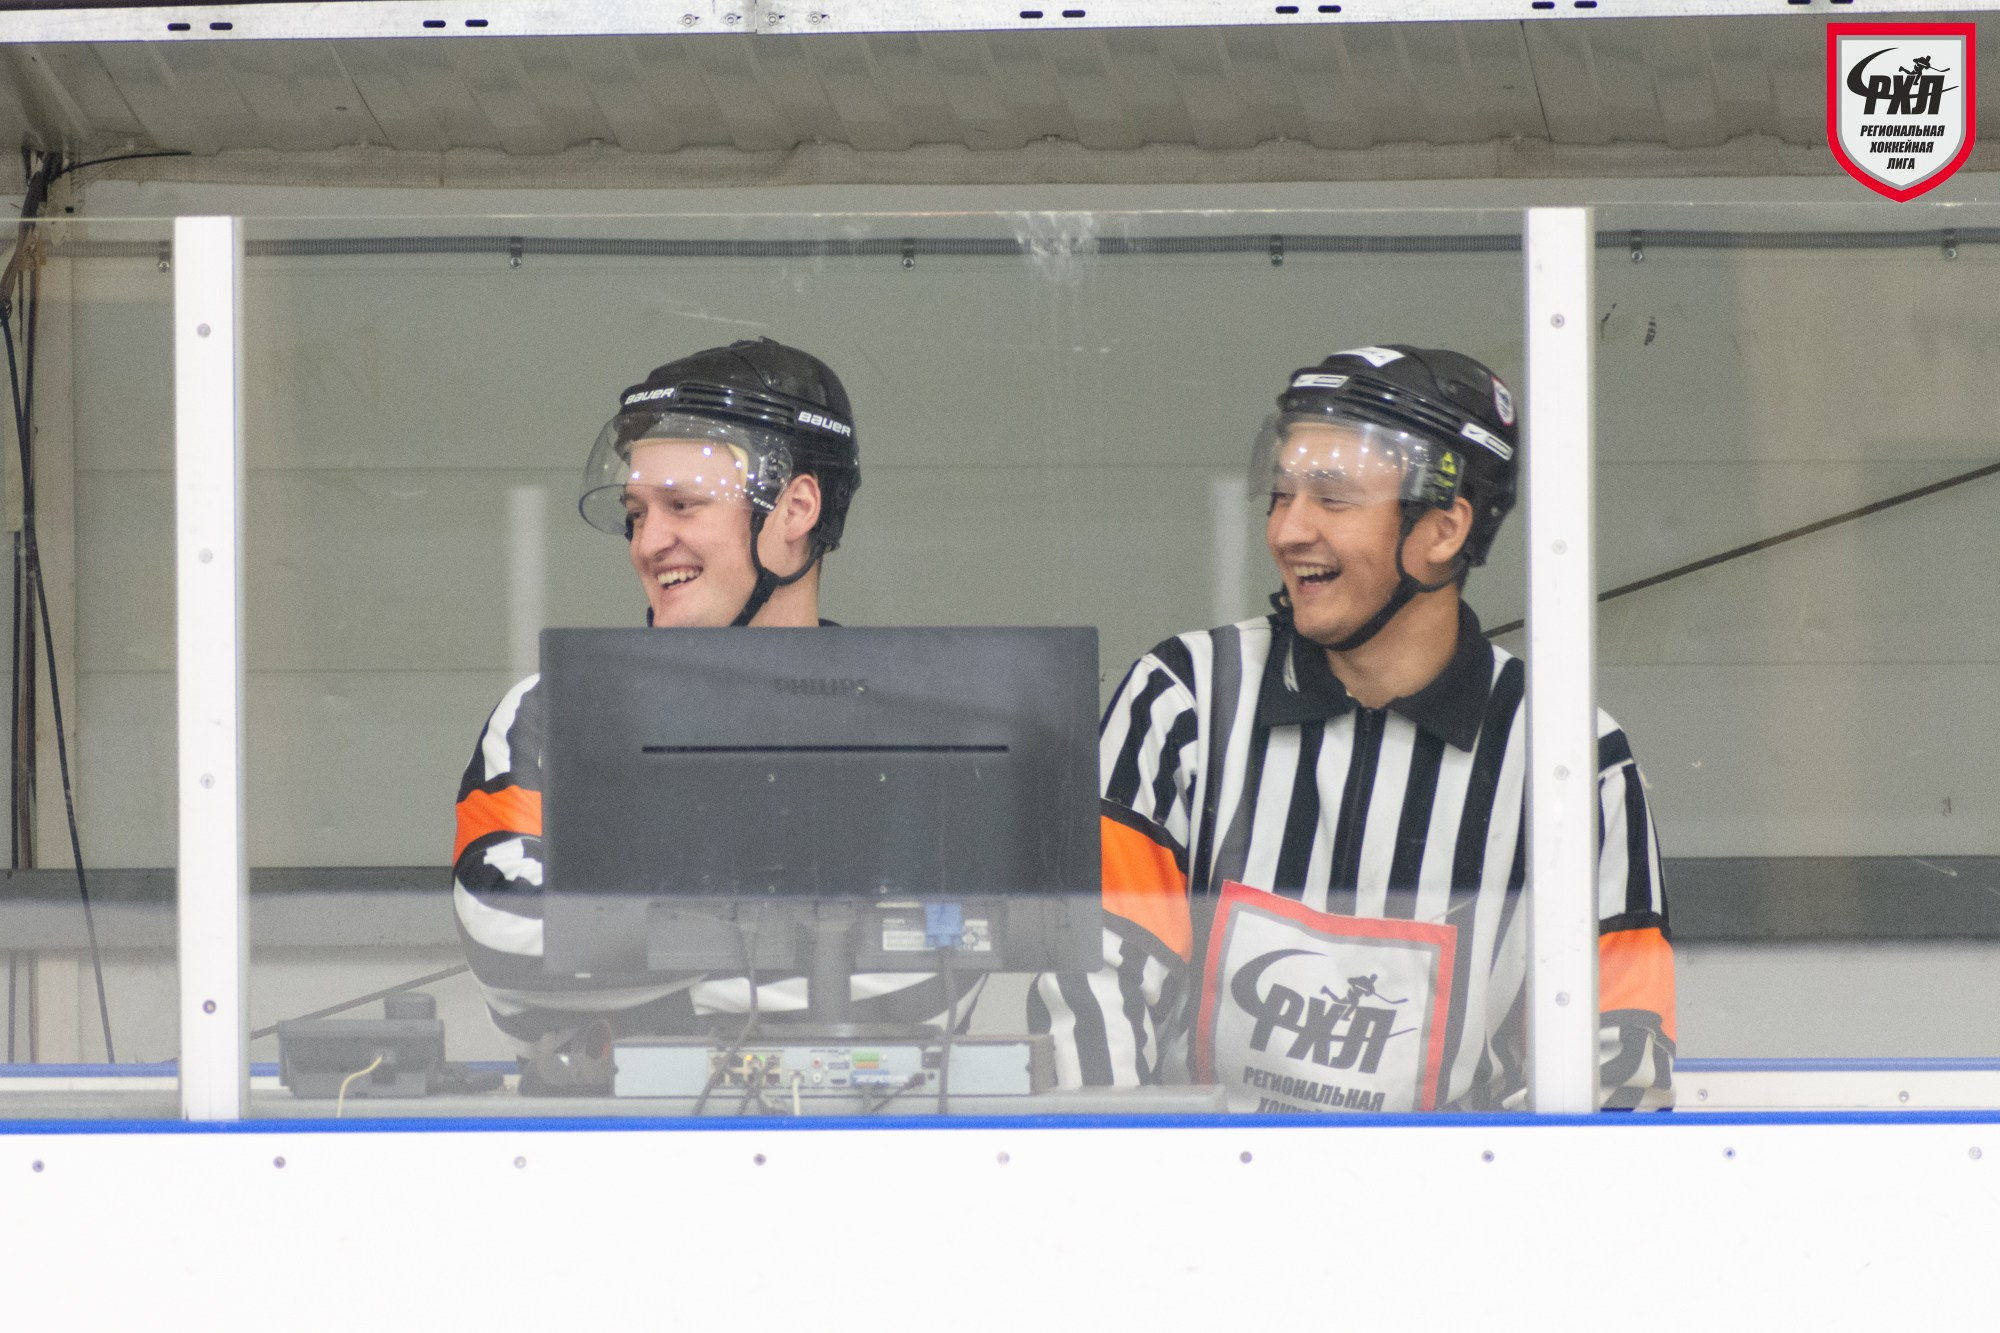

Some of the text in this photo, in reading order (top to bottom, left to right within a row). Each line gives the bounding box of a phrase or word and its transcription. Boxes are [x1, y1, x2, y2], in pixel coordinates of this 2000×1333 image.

[624, 387, 675, 406] BAUER
[798, 410, 852, 438] BAUER
[774, 678, 870, 697] PHILIPS
[1243, 1066, 1386, 1113] РЕГИОНАЛЬНАЯ
